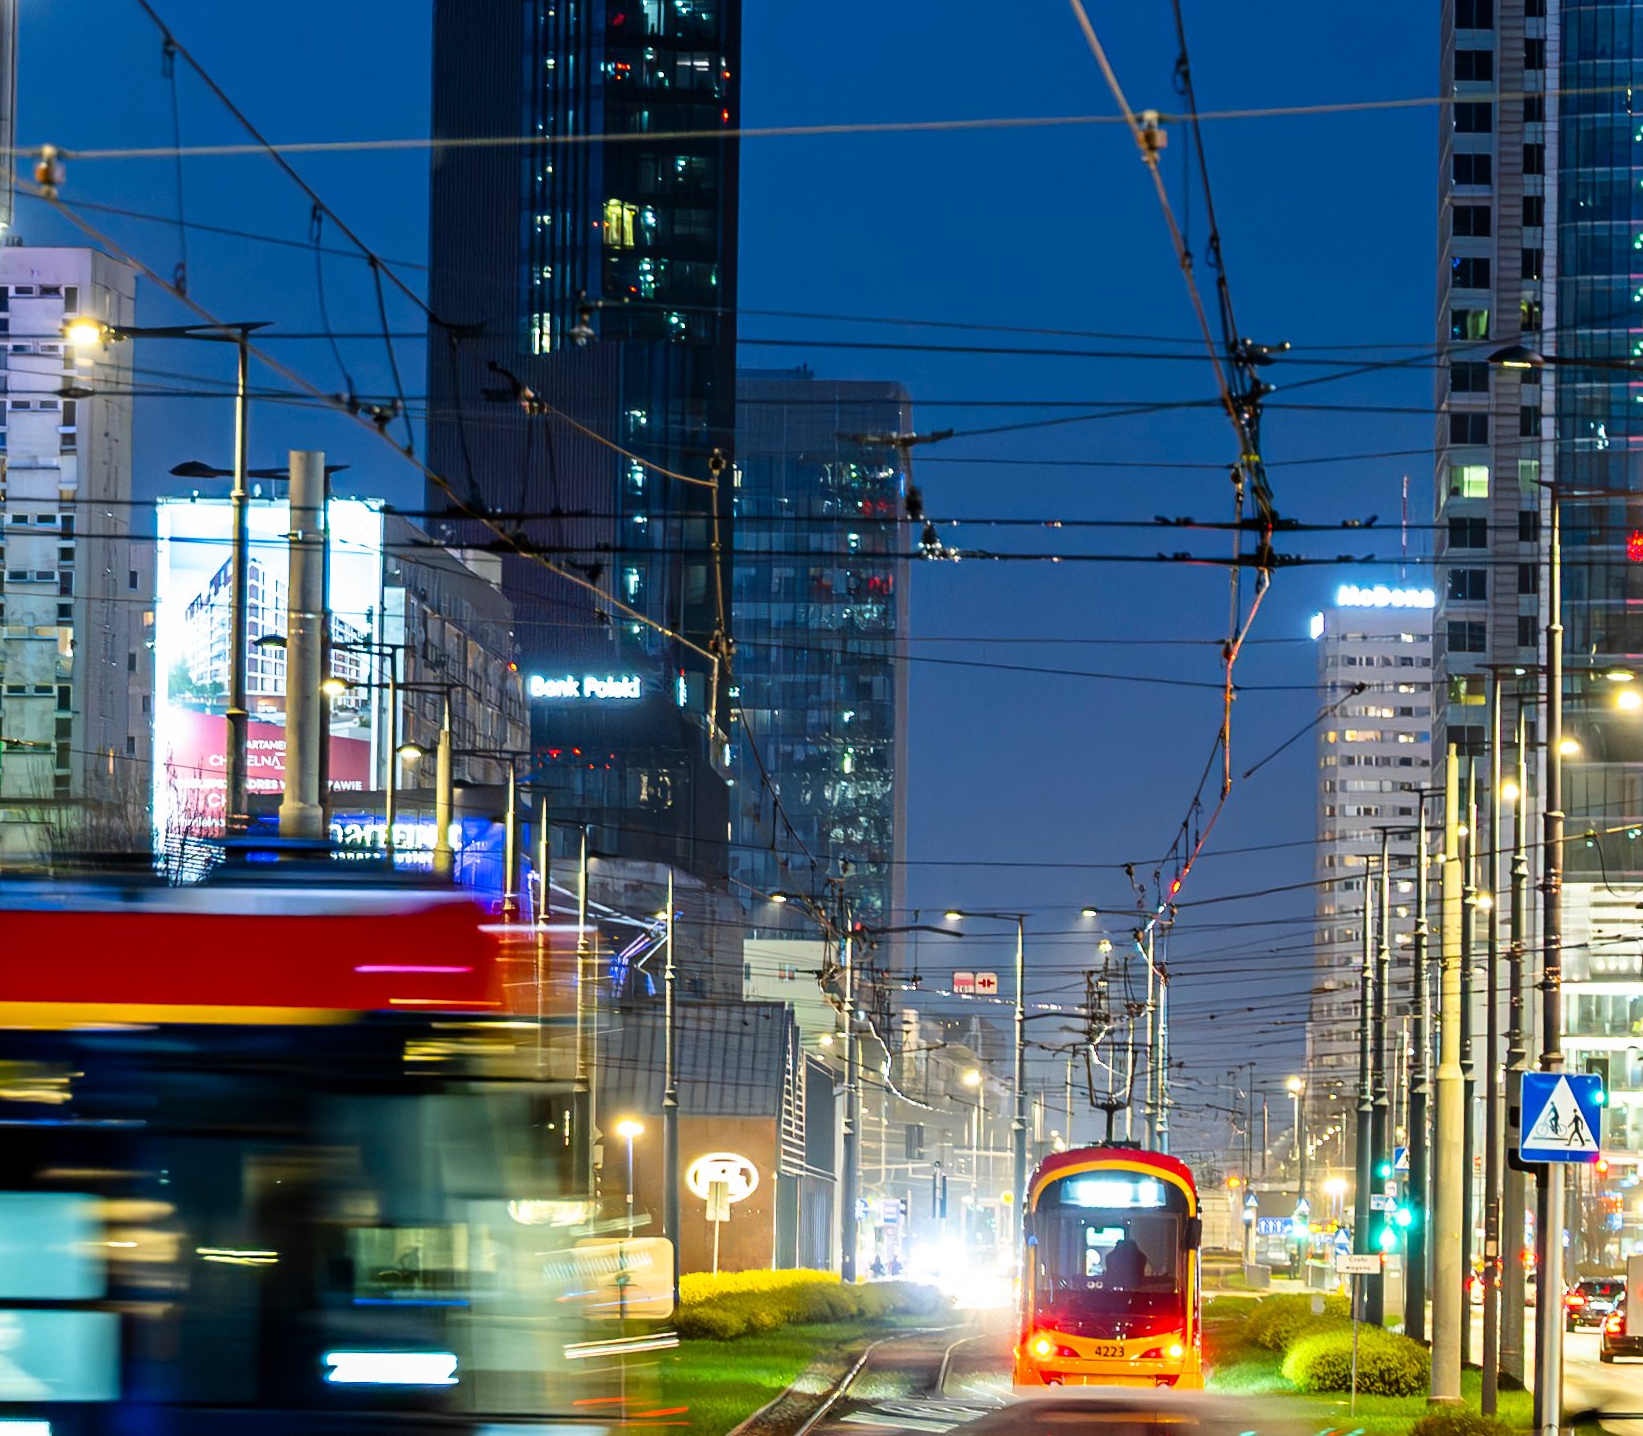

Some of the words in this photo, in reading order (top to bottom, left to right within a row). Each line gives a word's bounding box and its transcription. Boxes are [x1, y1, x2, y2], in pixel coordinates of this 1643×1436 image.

[530, 675, 579, 698] Bank
[583, 676, 641, 699] Polski
[1095, 1346, 1125, 1358] 4223
